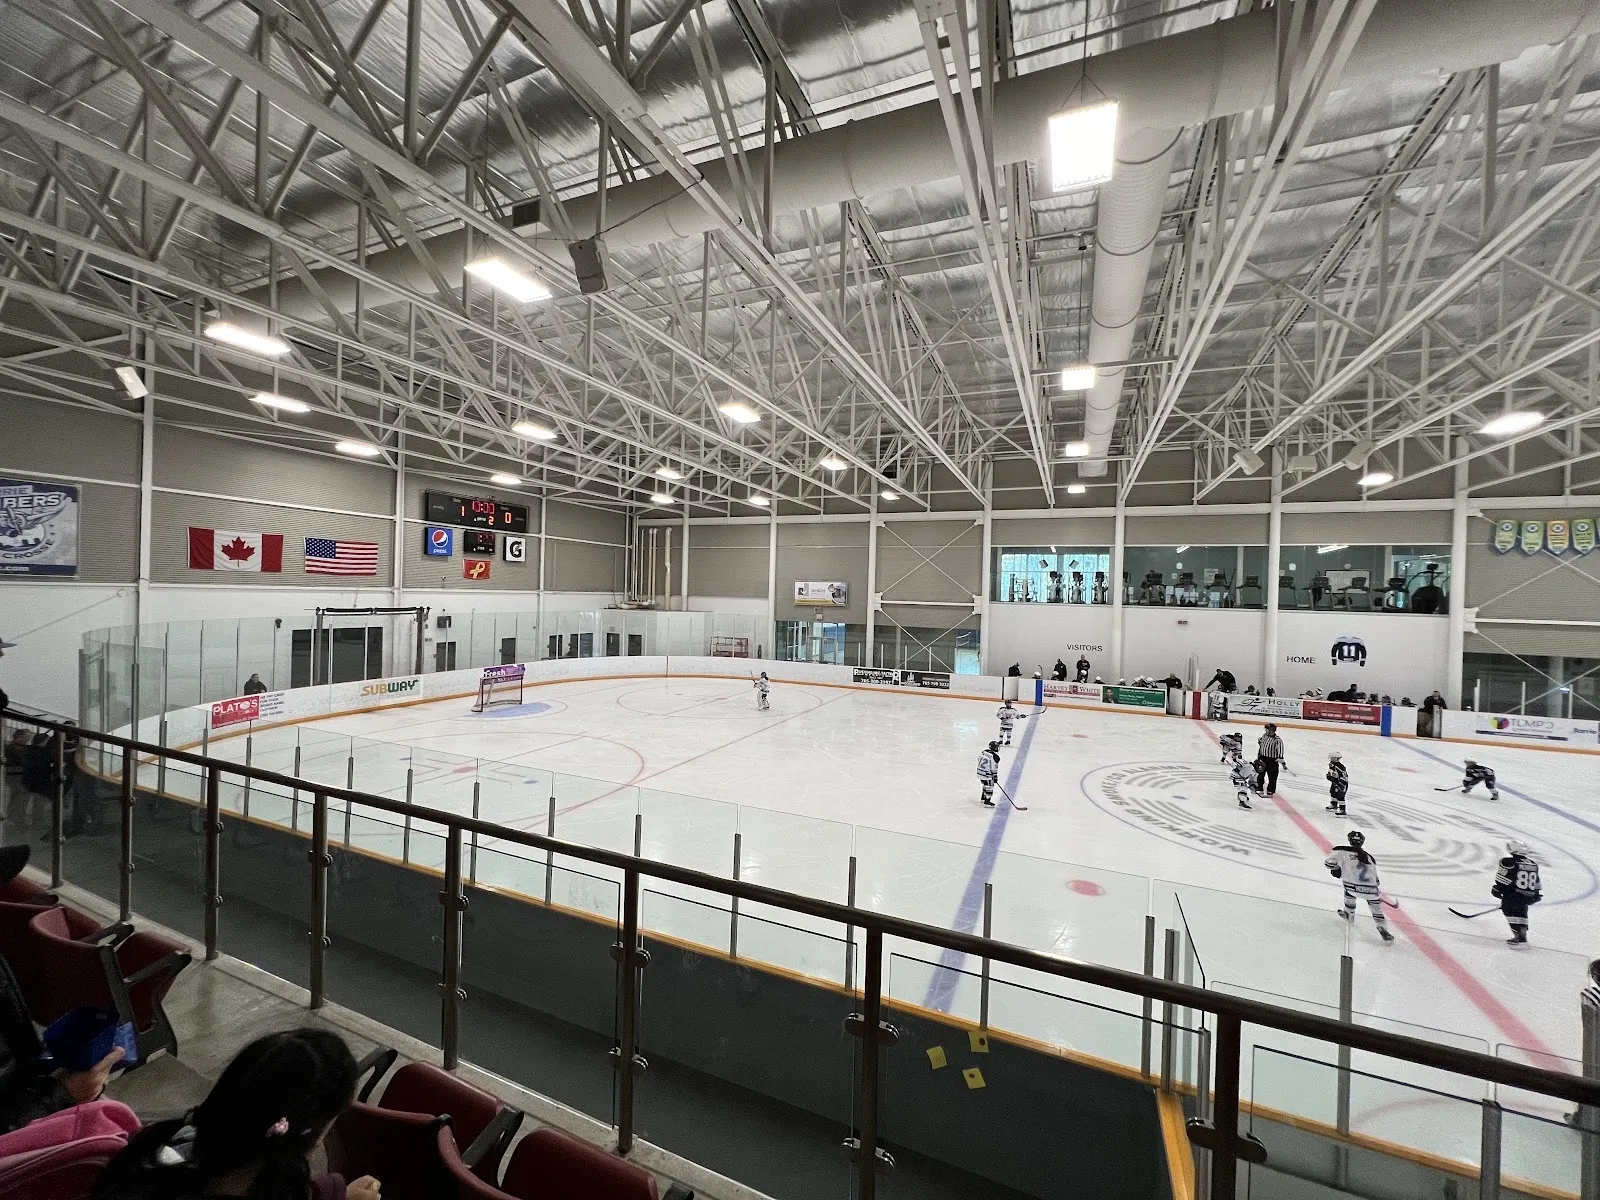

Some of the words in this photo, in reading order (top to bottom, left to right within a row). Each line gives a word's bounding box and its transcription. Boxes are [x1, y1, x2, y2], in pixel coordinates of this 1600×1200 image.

[0, 493, 60, 509] BERS
[1066, 643, 1103, 652] VISITORS
[1342, 645, 1356, 657] 11
[1286, 655, 1316, 664] HOME
[360, 679, 419, 697] SUBWAY
[1268, 699, 1300, 707] HOLLY
[1516, 870, 1537, 891] 88
